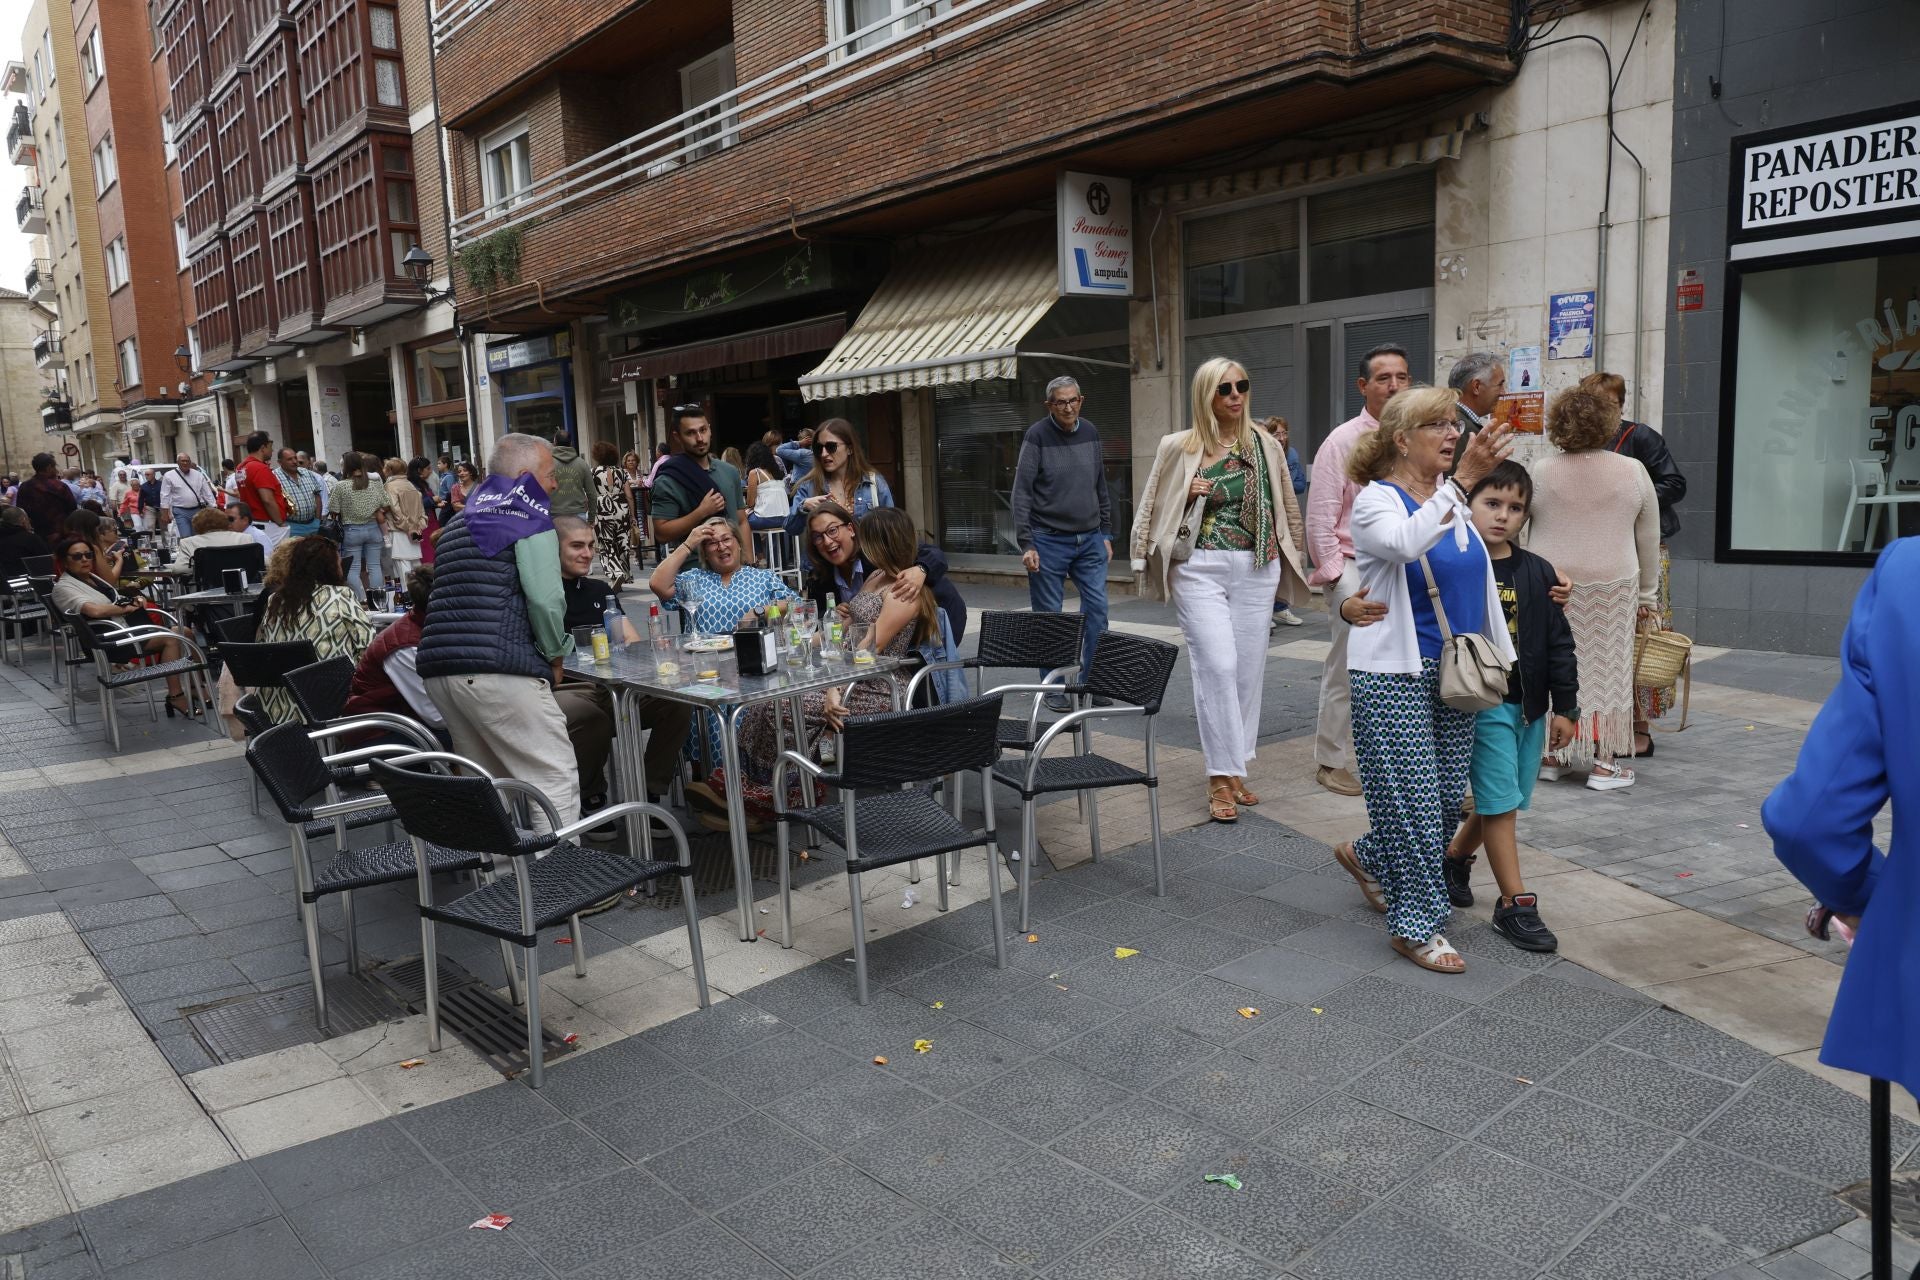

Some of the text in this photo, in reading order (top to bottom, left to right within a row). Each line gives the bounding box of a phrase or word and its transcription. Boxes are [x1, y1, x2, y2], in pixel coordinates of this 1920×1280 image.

[1750, 125, 1920, 182] PANADER
[1748, 168, 1920, 222] REPOSTER
[1094, 267, 1128, 280] ampudia
[1559, 309, 1585, 317] PALENCIA
[475, 493, 503, 506] San
